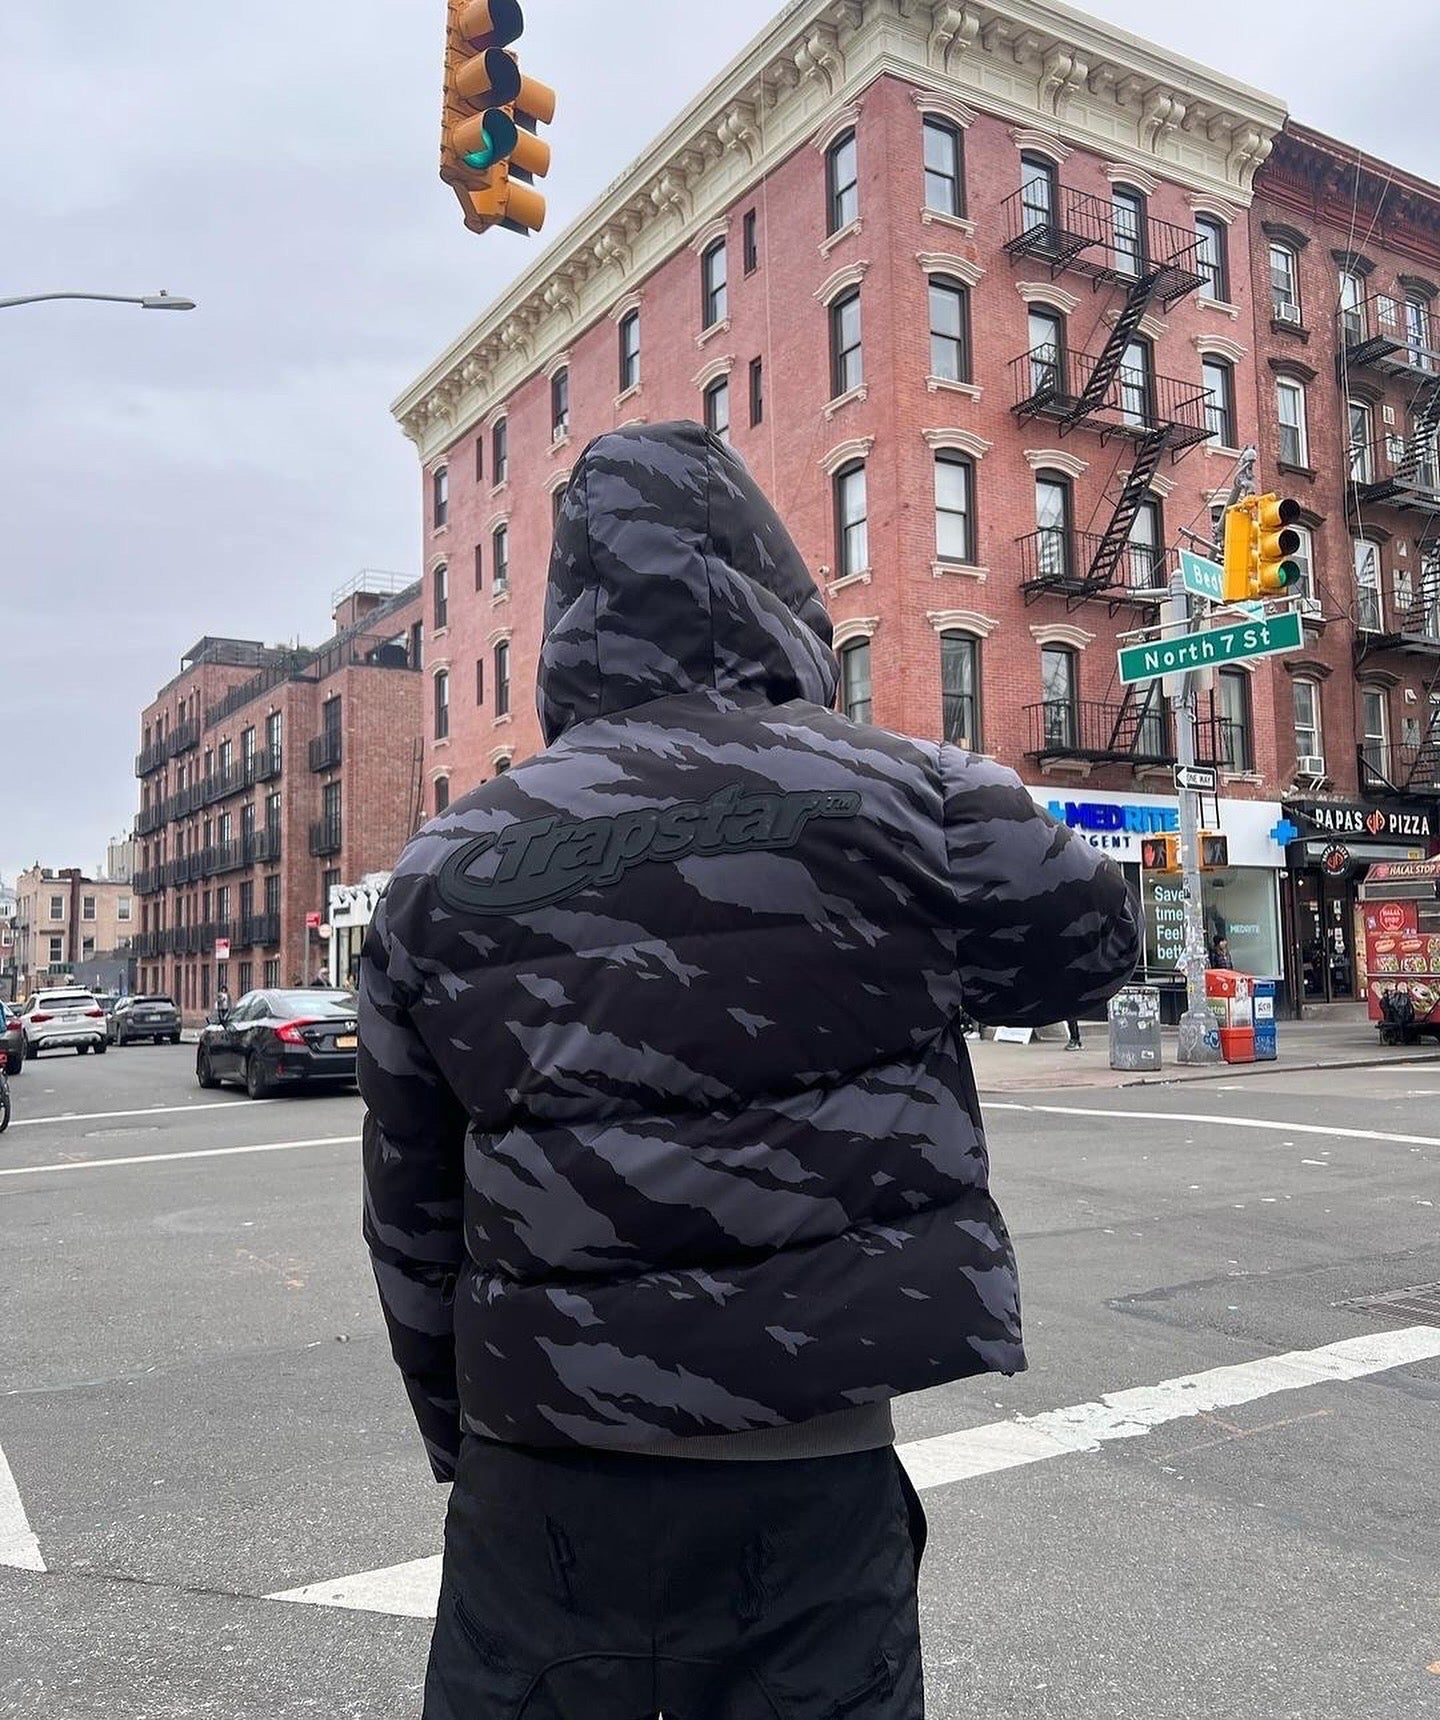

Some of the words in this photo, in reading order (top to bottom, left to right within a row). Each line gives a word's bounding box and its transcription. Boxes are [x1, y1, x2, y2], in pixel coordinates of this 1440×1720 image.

[1144, 637, 1214, 670] North
[1220, 634, 1234, 653] 7
[1243, 627, 1270, 649] St
[1186, 773, 1198, 784] ONE
[1200, 775, 1211, 785] WAY
[1065, 801, 1181, 833] MEDRITE
[1315, 808, 1364, 831] PAPA'S
[1389, 813, 1430, 835] PIZZA
[488, 785, 820, 886] Trapstar
[1081, 834, 1132, 849] GENT
[1389, 865, 1414, 876] HALAL
[1415, 863, 1436, 875] STOP
[1154, 886, 1184, 901] Save
[1155, 906, 1184, 921] time
[1156, 925, 1183, 940] Feel
[1157, 943, 1183, 960] bett
